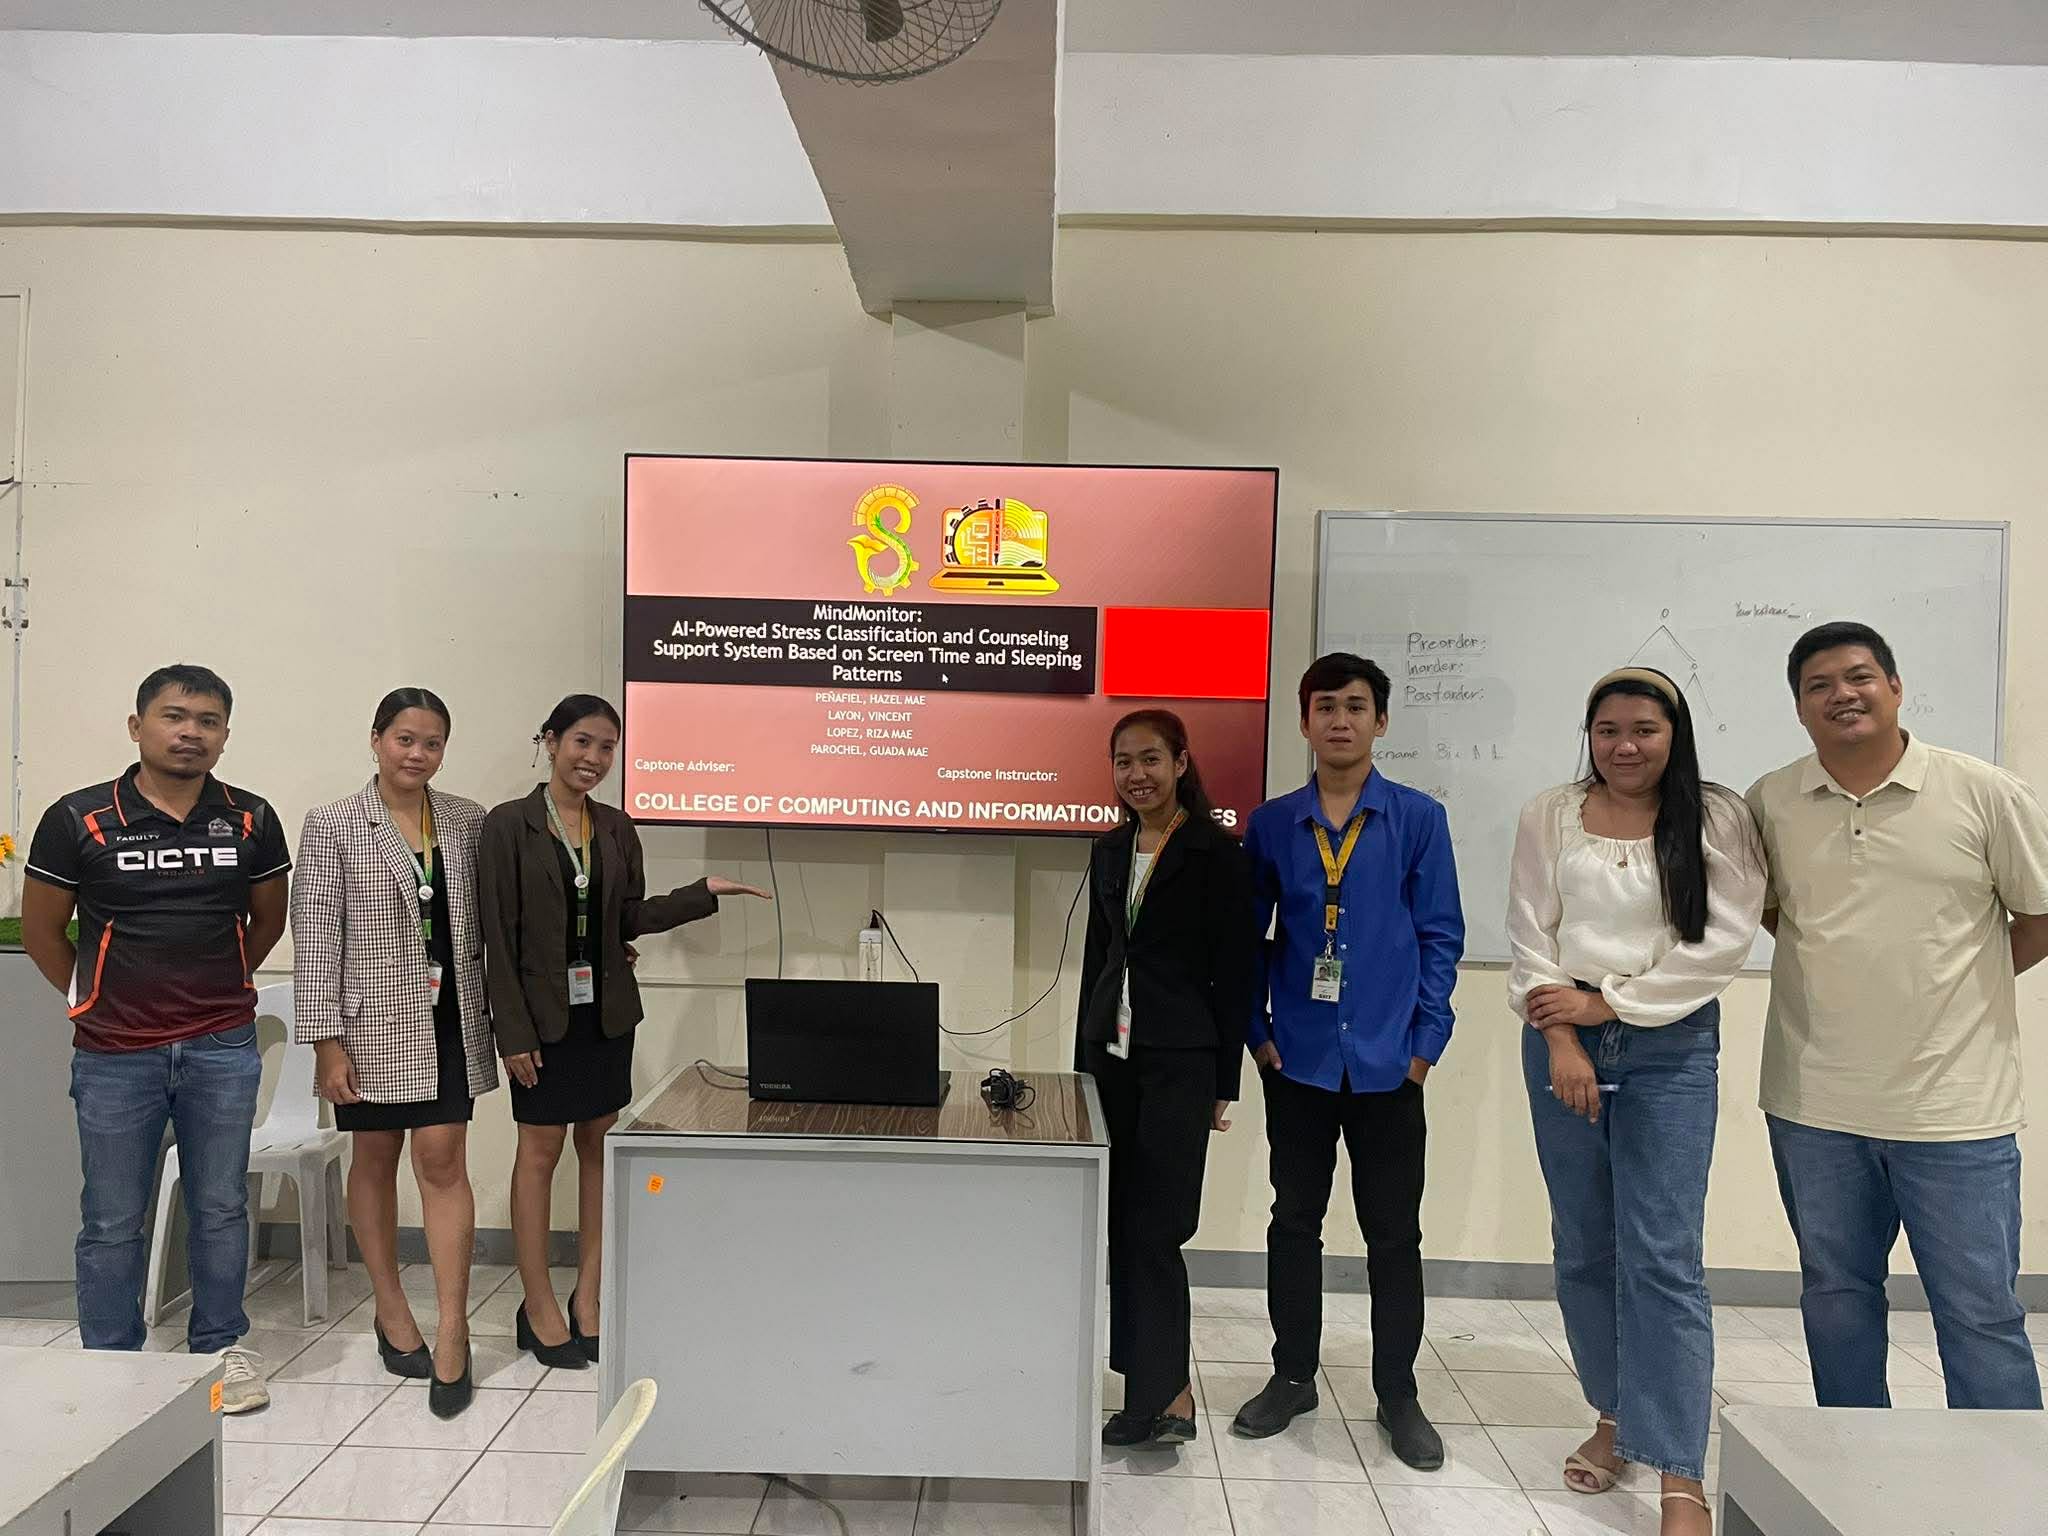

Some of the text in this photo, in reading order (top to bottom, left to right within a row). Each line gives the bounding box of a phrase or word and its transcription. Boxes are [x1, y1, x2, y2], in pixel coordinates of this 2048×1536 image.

[813, 604, 922, 623] MindMonitor:
[671, 620, 1069, 650] AI-Powered Stress Classification and Counseling
[1407, 632, 1486, 654] Preorder:
[653, 640, 1082, 671] Support System Based on Screen Time and Sleeping
[832, 665, 902, 682] Patterns
[815, 690, 926, 705] PEÑAFIEL, HAZEL MAE
[828, 710, 913, 722] LAYON, VINCENT
[827, 727, 913, 739] LOPEZ, RIZA MAE
[810, 744, 929, 757] PAROCHEL, GUADA MAE
[634, 758, 735, 772] Captone Adviser:
[937, 767, 1058, 782] Capstone Instructor:
[634, 792, 738, 813] COLLEGE
[743, 796, 773, 813] OF
[778, 796, 911, 818] COMPUTING
[915, 800, 963, 819] AND
[968, 801, 1120, 823] INFORMATION
[117, 847, 238, 871] CICTE
